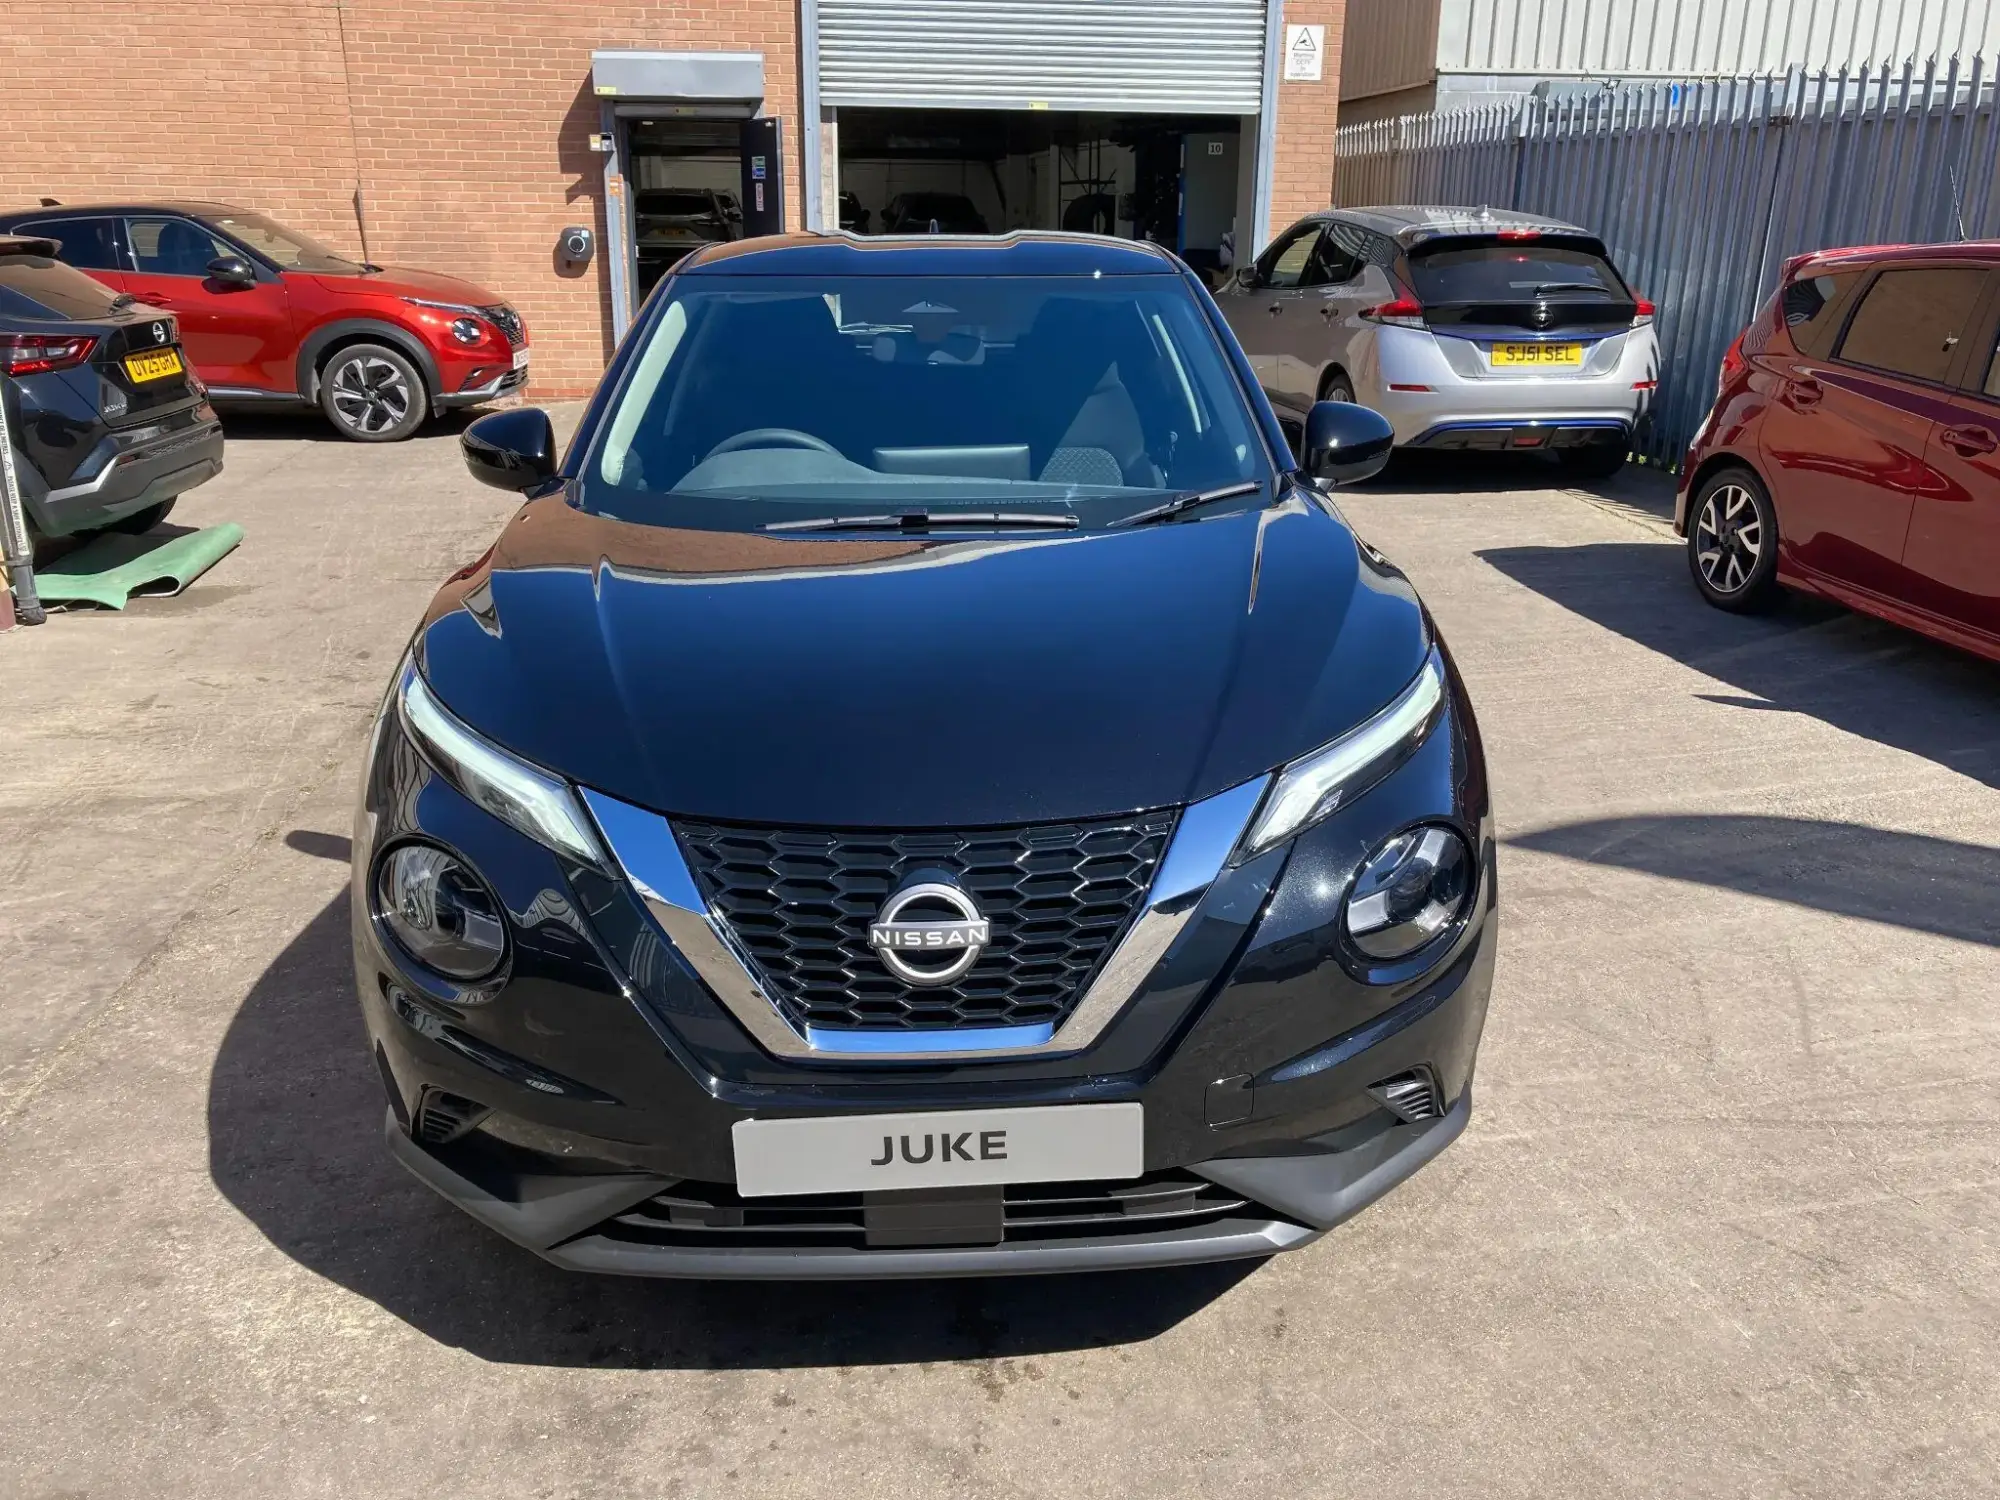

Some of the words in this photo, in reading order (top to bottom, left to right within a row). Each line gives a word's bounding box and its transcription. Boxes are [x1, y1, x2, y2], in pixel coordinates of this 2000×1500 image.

[1211, 144, 1221, 153] 10
[1506, 345, 1540, 361] SJ51
[1545, 345, 1574, 361] SEL
[872, 926, 987, 946] NISSAN
[870, 1130, 1008, 1167] JUKE
